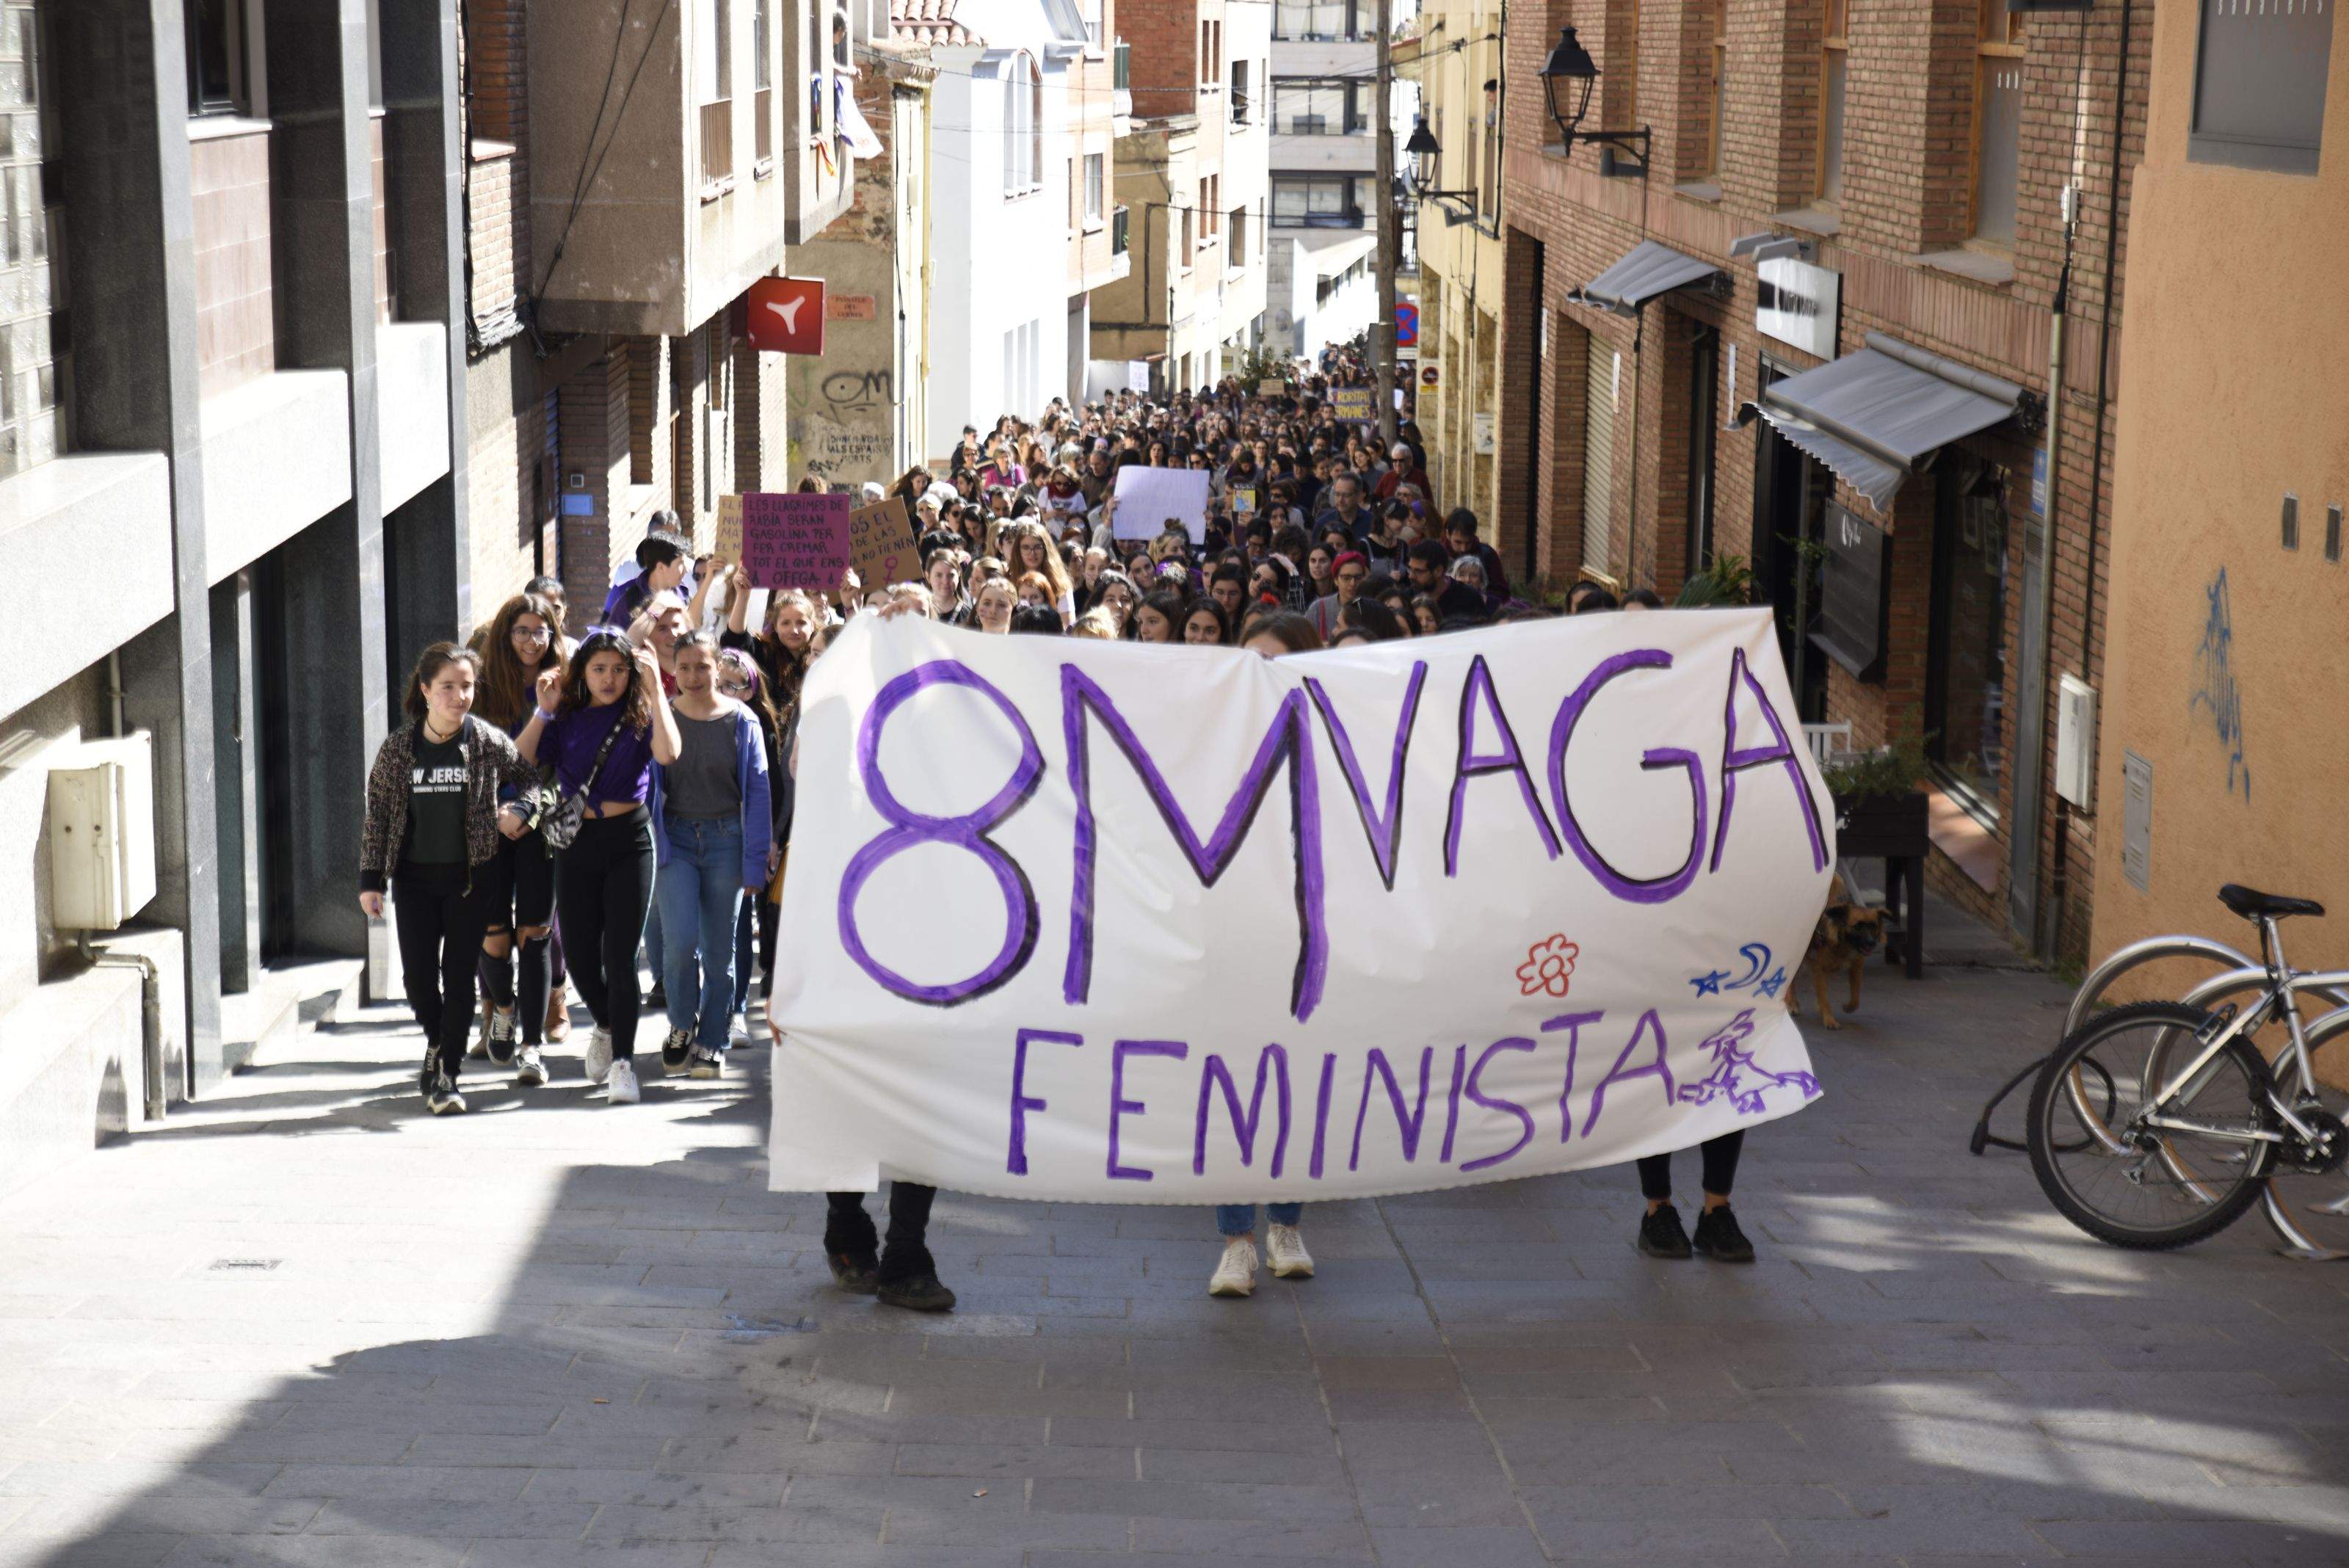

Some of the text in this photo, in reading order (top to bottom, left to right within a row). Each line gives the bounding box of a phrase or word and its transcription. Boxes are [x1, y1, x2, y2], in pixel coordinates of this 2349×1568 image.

[749, 498, 769, 512] LES
[830, 499, 843, 512] DE
[788, 514, 824, 526] SERAN
[811, 527, 834, 540] PER
[752, 541, 829, 554] FER CREMAR
[752, 556, 844, 568] TOT EL QUE ENS
[862, 549, 875, 562] NO
[772, 570, 821, 585] OFEGA
[1006, 1008, 1676, 1180] FEMINISTA
